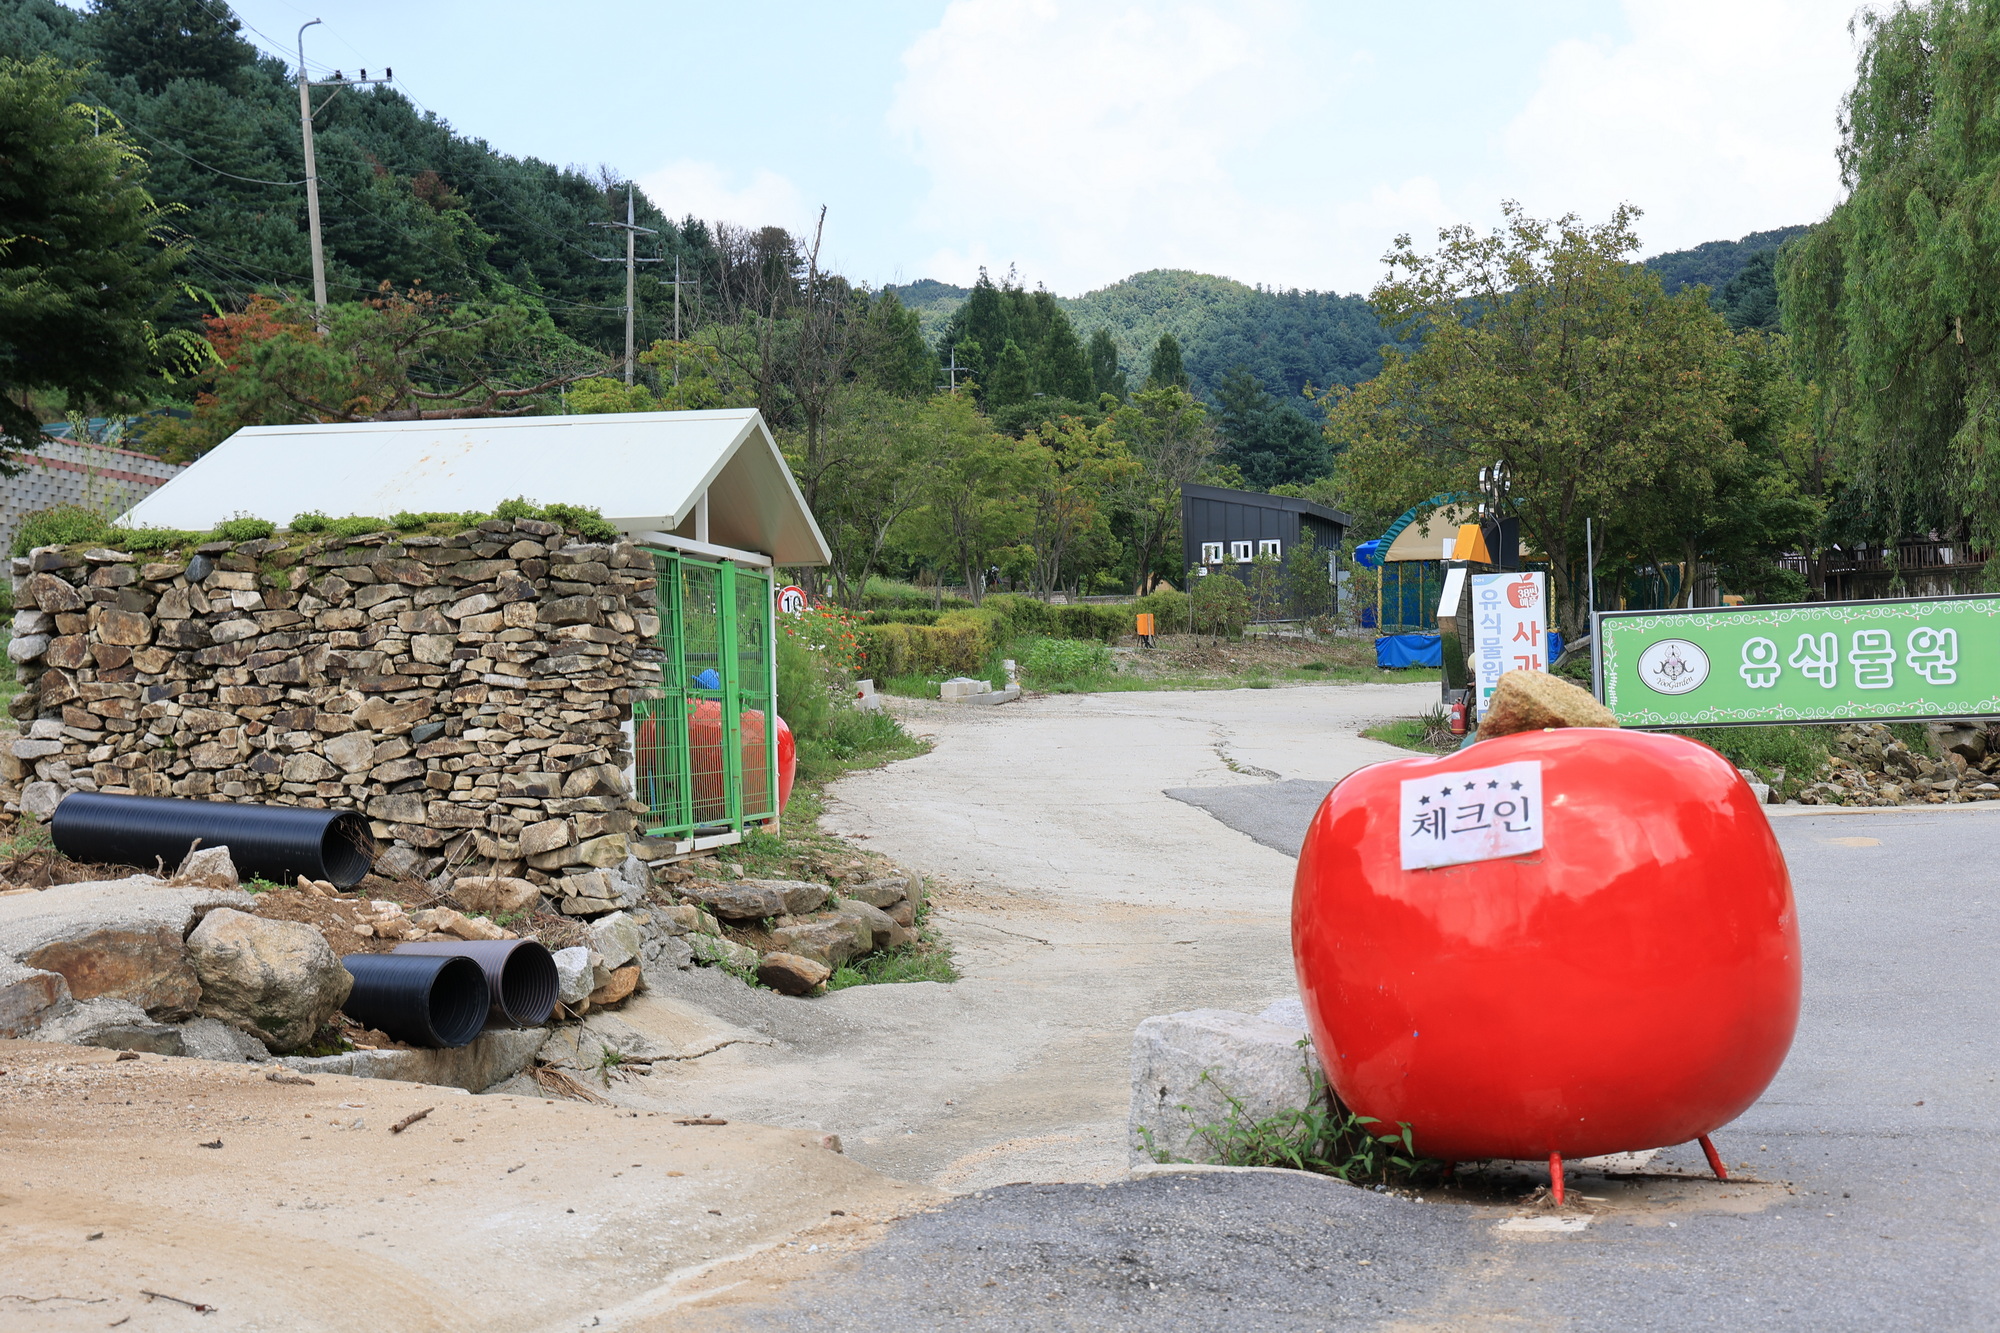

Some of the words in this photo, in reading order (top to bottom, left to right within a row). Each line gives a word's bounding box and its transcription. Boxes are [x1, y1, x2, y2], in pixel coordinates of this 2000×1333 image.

[784, 595, 801, 612] 10
[1479, 589, 1504, 684] 유식물원
[1739, 626, 1958, 690] 유식물원
[1656, 675, 1694, 690] YooGarden
[1410, 796, 1532, 841] 체크인
